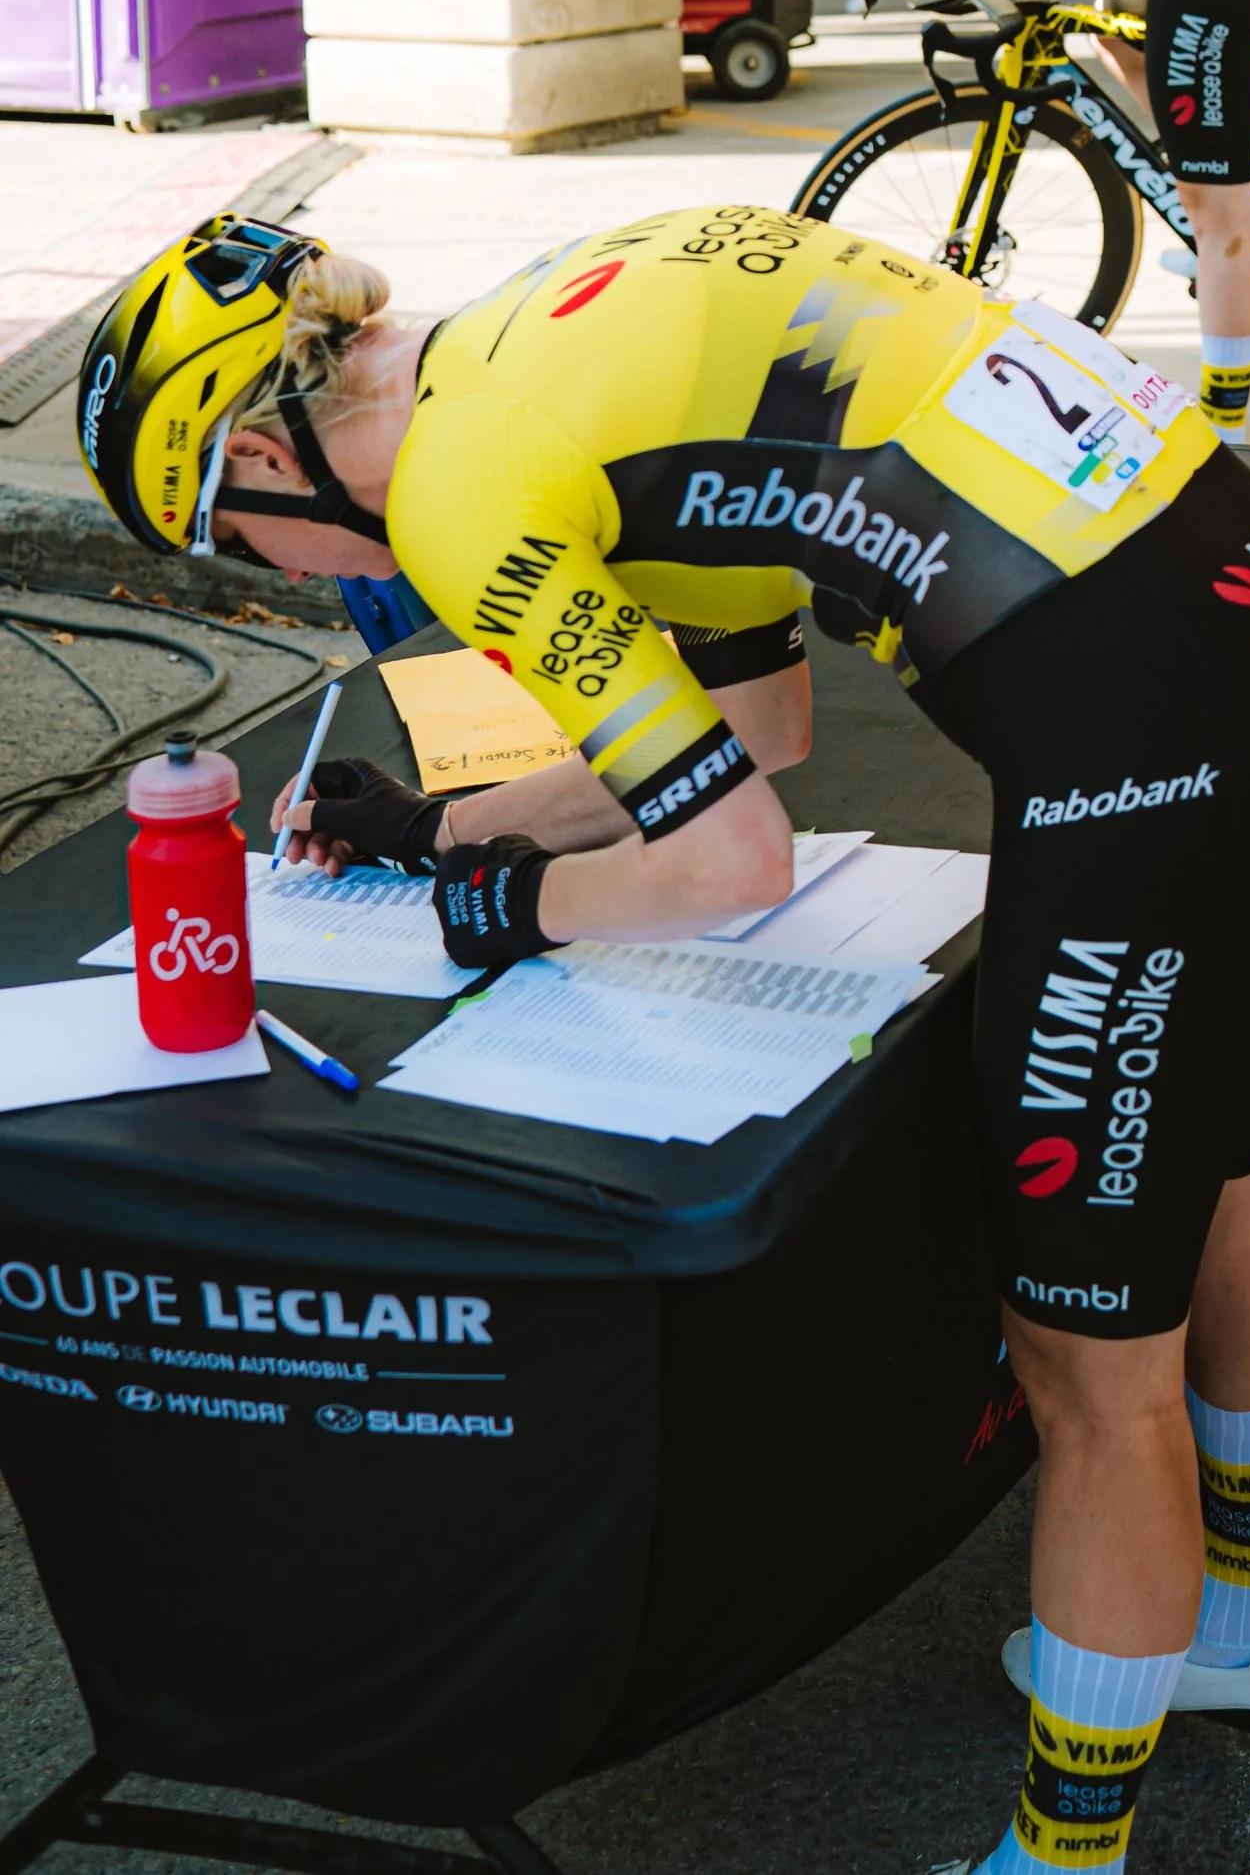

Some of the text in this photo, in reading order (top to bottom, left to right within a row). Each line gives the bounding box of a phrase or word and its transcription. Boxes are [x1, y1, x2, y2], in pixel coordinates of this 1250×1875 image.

[1166, 12, 1210, 87] VISMA
[1201, 76, 1225, 127] lease
[816, 132, 888, 207] RESERVE
[1180, 159, 1229, 175] nimbl
[80, 353, 117, 470] GIRO
[985, 353, 1092, 436] 2
[162, 464, 182, 507] VISMA
[676, 467, 950, 605] Rabobank
[473, 535, 568, 637] VISMA
[531, 589, 606, 685] lease
[479, 748, 537, 765] Senior
[636, 734, 746, 828] SRAM
[1021, 762, 1221, 830] Rabobank
[457, 881, 470, 924] lease
[470, 888, 489, 936] VISMA
[1020, 937, 1130, 1110] VISMA
[1086, 1085, 1152, 1206] lease
[200, 1281, 494, 1345] LECLAIR
[1016, 1275, 1130, 1312] nimbl
[82, 1339, 120, 1360] ANS
[150, 1347, 235, 1373] PASSION
[237, 1354, 370, 1382] AUTOMOBILE
[167, 1391, 290, 1426] HYUNDAI
[366, 1408, 514, 1438] SUBARU
[1064, 1737, 1149, 1765] VISMA
[1057, 1778, 1125, 1800] lease
[1054, 1828, 1121, 1853] nimbl
